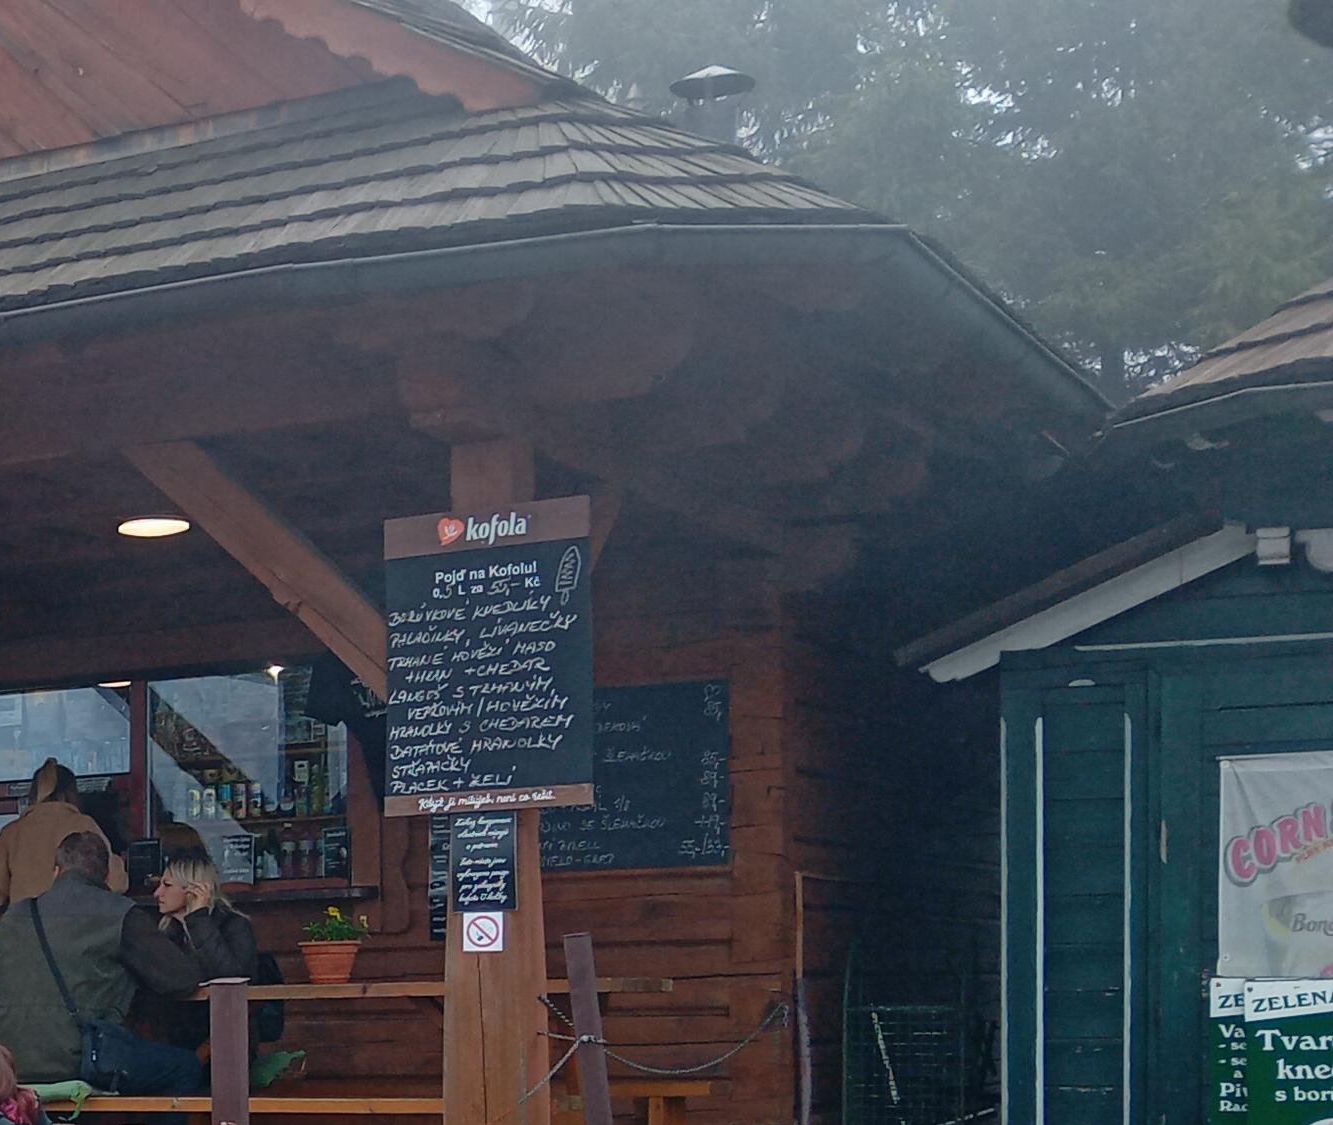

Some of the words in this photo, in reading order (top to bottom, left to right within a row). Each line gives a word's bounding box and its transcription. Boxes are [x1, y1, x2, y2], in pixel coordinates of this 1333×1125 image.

[465, 511, 527, 545] kofola
[435, 569, 467, 585] Pojď
[469, 569, 486, 580] na
[488, 561, 537, 578] Kofolu!
[457, 585, 466, 596] L
[470, 585, 484, 594] za
[524, 576, 541, 589] Kč
[513, 640, 556, 655] MASO
[389, 720, 452, 741] HRANOLKY
[479, 713, 575, 732] CHEDAREM
[470, 733, 563, 755] HRANOLKY
[389, 778, 450, 795] PLACEK
[1227, 802, 1327, 885] CORN
[1252, 991, 1333, 1013] ZELEN
[1275, 1090, 1287, 1102] s
